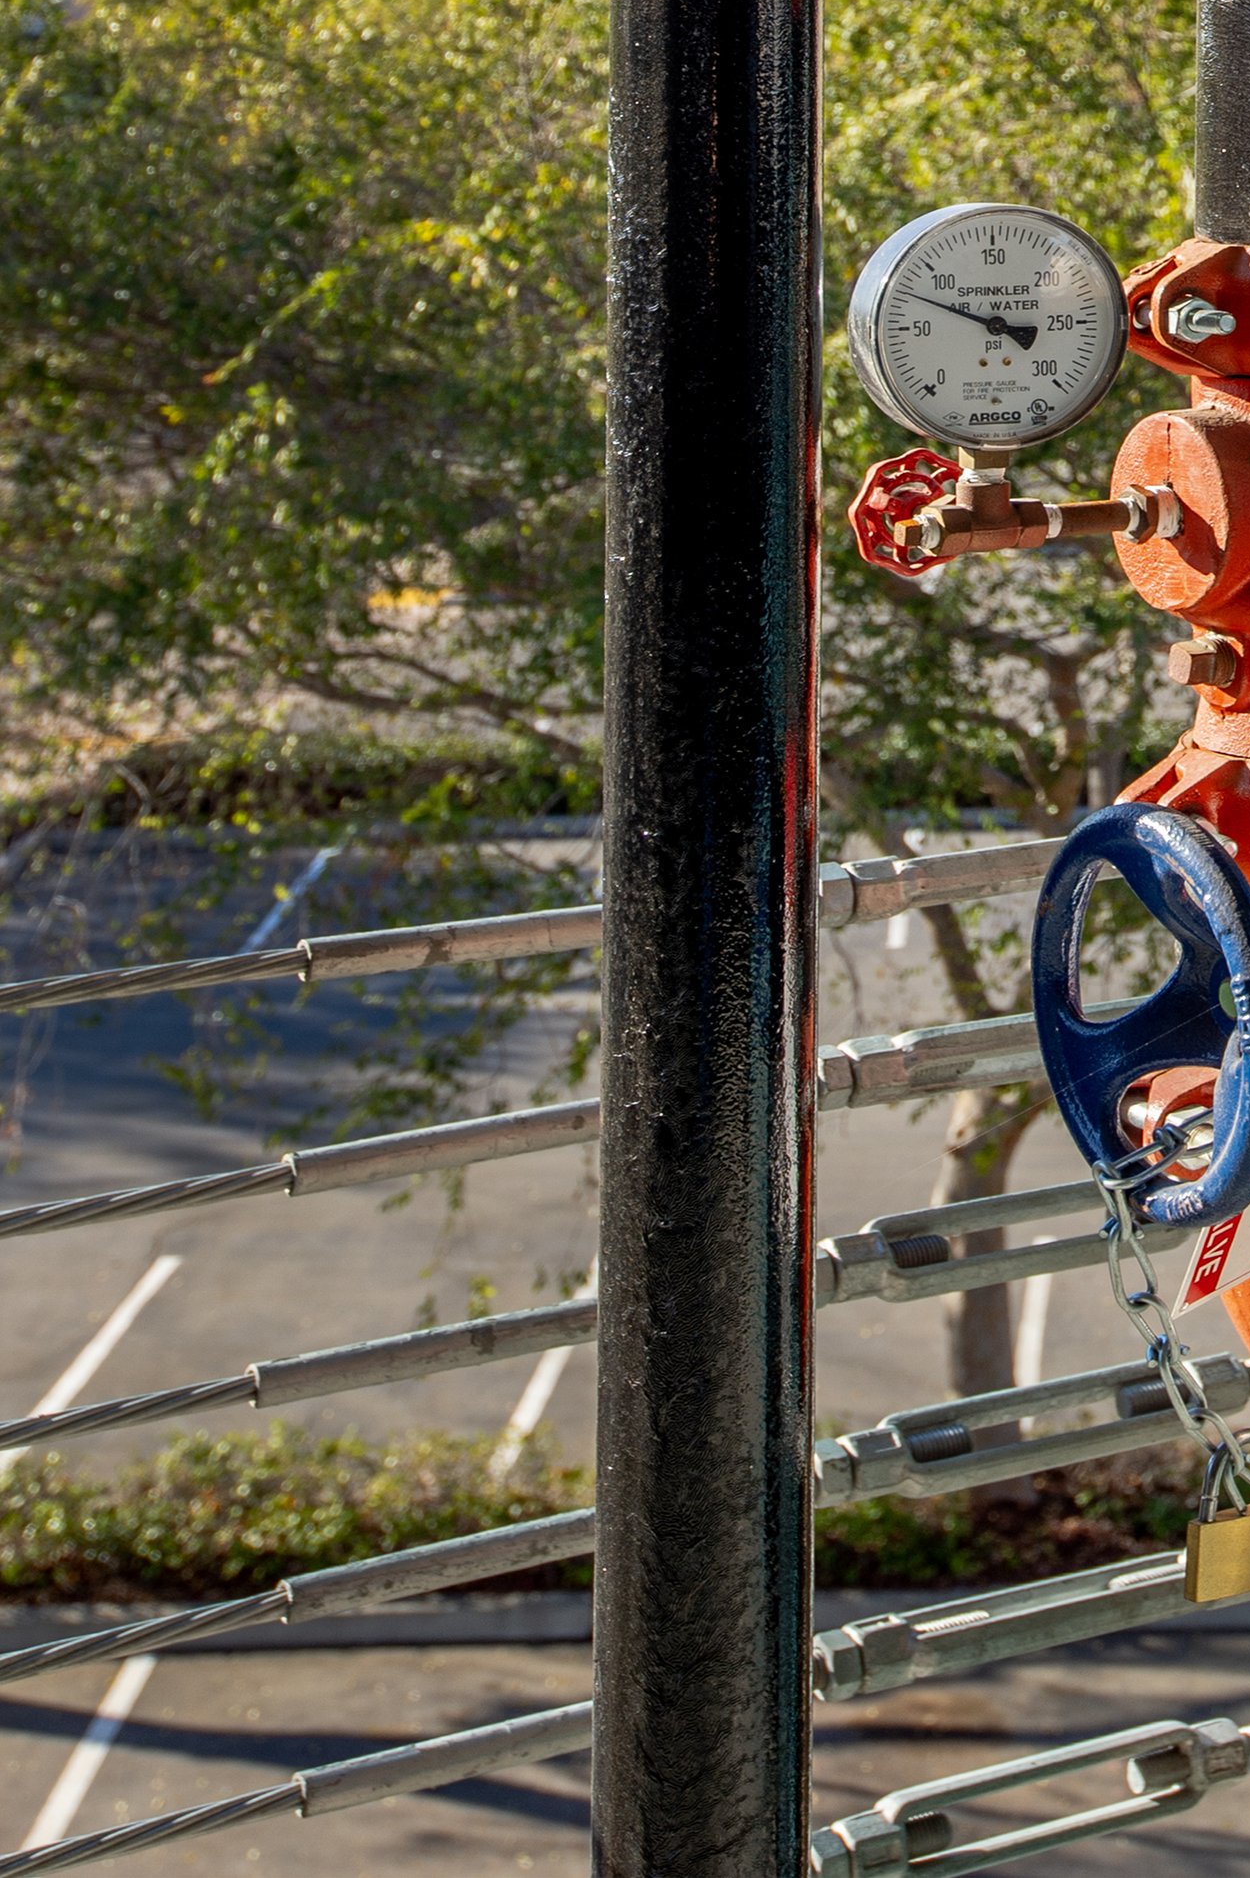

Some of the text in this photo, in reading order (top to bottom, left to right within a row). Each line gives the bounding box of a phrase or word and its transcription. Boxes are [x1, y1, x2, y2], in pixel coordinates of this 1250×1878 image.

[981, 249, 1006, 265] 150
[931, 274, 956, 290] 100
[1034, 271, 1060, 287] 200
[957, 285, 1030, 297] SPRINKLER
[949, 302, 971, 313] AIR
[990, 300, 1039, 311] WATER
[913, 321, 931, 336] 50
[1047, 315, 1073, 331] 250
[985, 337, 1002, 353] psi
[1032, 360, 1057, 376] 300
[937, 369, 945, 384] 0
[969, 411, 1021, 422] ARGCO
